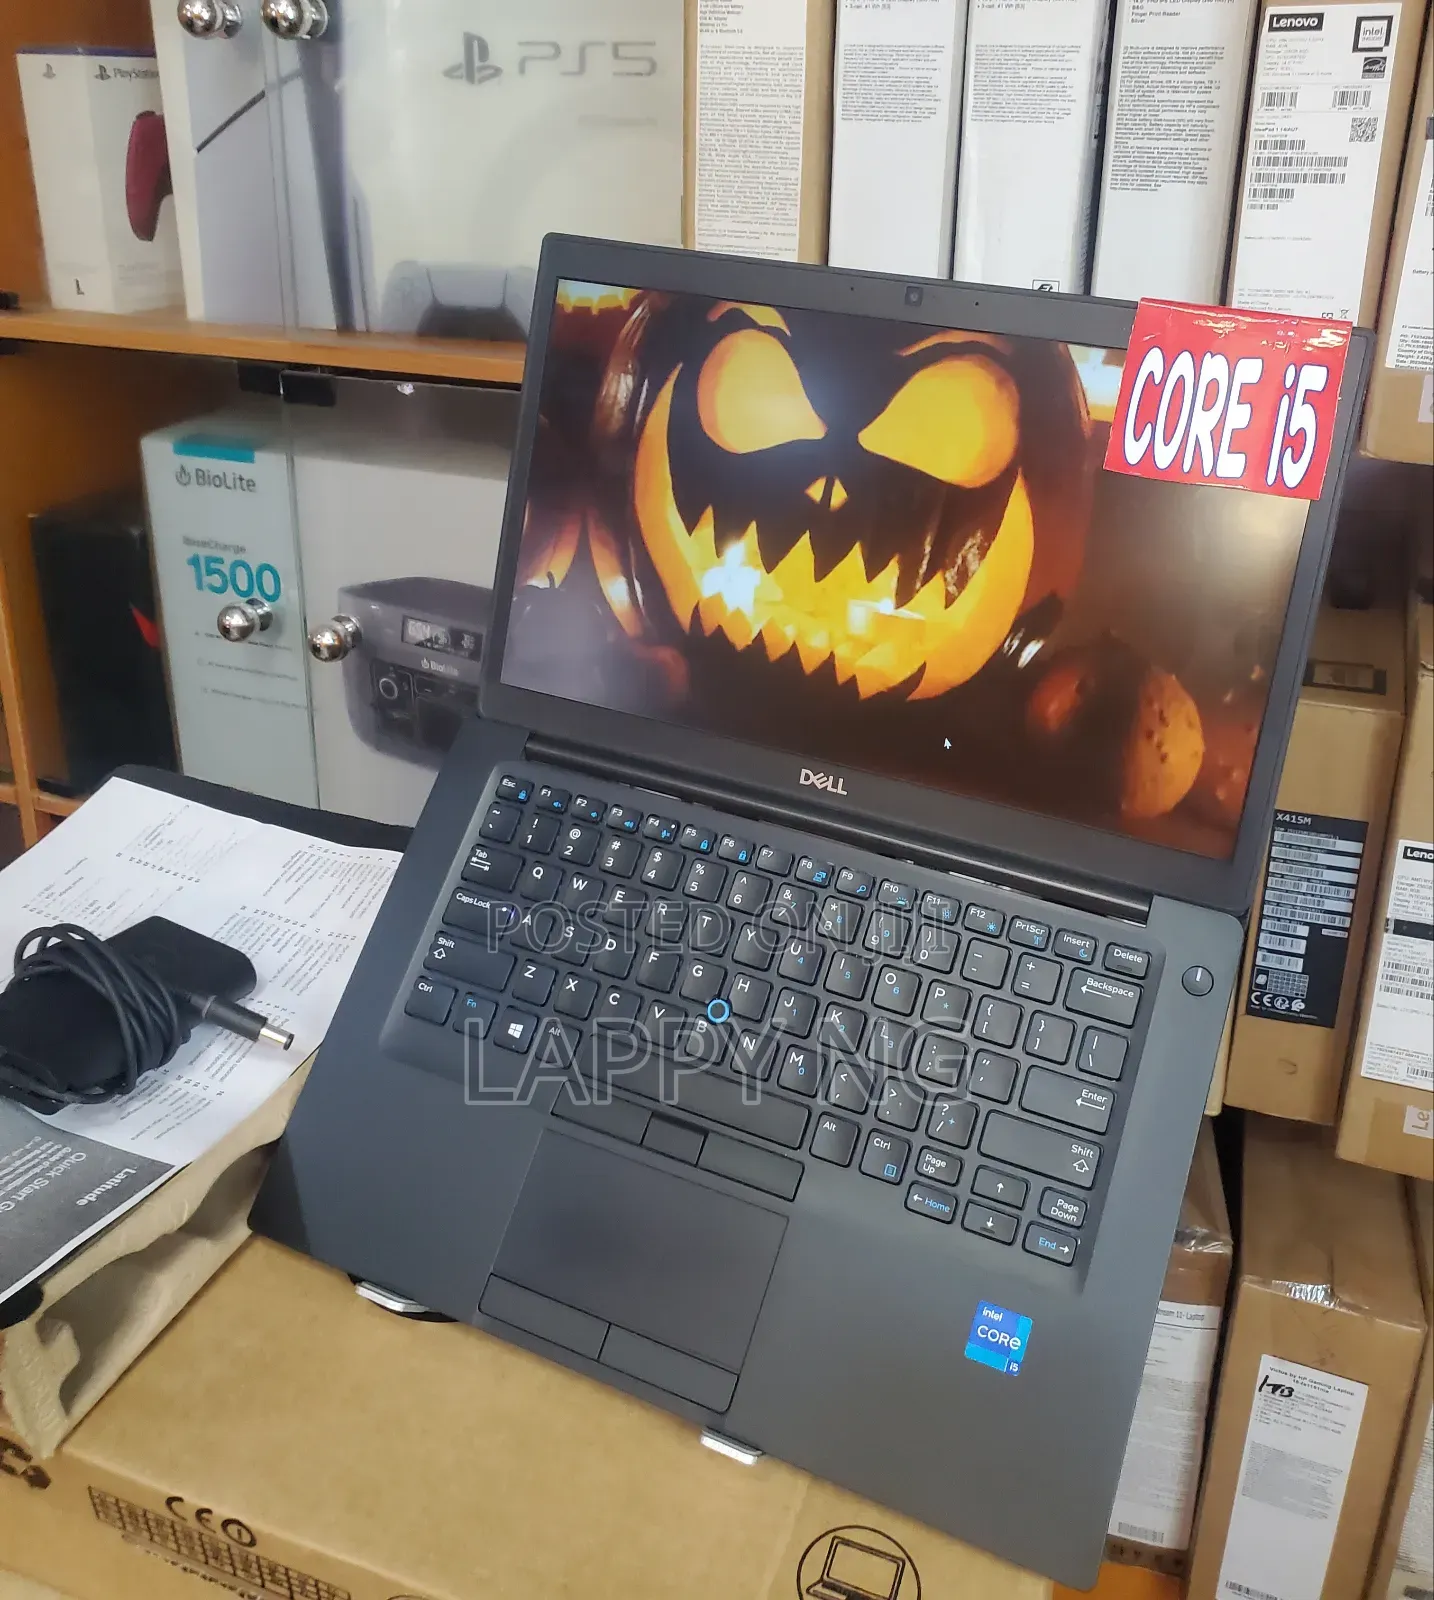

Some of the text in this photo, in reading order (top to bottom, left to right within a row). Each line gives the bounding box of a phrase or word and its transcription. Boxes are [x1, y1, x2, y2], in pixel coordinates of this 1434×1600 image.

[1272, 16, 1319, 28] Lenovo
[1362, 26, 1384, 36] intel
[516, 40, 658, 77] PS5
[1123, 346, 1329, 489] CORE i5
[195, 467, 257, 492] BioLite
[183, 535, 247, 555] BaseCharge
[187, 553, 282, 603] 1500
[502, 778, 517, 788] Esc
[799, 768, 848, 796] DELL
[541, 789, 552, 798] F1
[576, 798, 588, 807] F2
[611, 807, 623, 817] F3
[1275, 812, 1312, 825] X415M
[649, 818, 660, 828] F4
[526, 834, 533, 845] 1
[685, 828, 697, 838] F5
[723, 838, 735, 848] F6
[475, 848, 488, 859] Tab
[563, 845, 574, 856] 2
[762, 849, 774, 859] F7
[605, 856, 614, 867] 3
[801, 860, 813, 870] F8
[532, 866, 544, 880] Q
[647, 869, 657, 879] 4
[841, 871, 854, 881] F9
[572, 877, 588, 891] W
[689, 881, 699, 892] 5
[883, 882, 899, 894] F10
[614, 890, 625, 903] E
[733, 893, 743, 904] 6
[926, 895, 941, 906] F11
[656, 903, 668, 915] R
[970, 908, 986, 919] F12
[521, 914, 532, 926] A
[702, 916, 712, 928] T
[823, 920, 833, 931] 8
[563, 926, 575, 938] S
[745, 928, 756, 942] Y
[1015, 921, 1045, 936] PrtScr
[437, 936, 455, 949] Shift
[605, 938, 617, 951] D
[870, 934, 880, 945] 9
[1063, 934, 1090, 949] Insert
[790, 942, 802, 955] U
[648, 951, 659, 964] F
[1113, 948, 1143, 963] Delete
[839, 958, 845, 970] I
[523, 965, 536, 979] Z
[692, 965, 704, 977] G
[844, 971, 851, 980] 5
[565, 978, 579, 992] X
[885, 972, 897, 985] O
[418, 981, 433, 993] Ctrl
[737, 978, 750, 993] H
[893, 986, 900, 995] 6
[1086, 977, 1135, 999] Backspace
[609, 993, 620, 1005] C
[934, 987, 946, 999] P
[466, 998, 477, 1008] Fn
[784, 996, 795, 1008] J
[654, 1006, 665, 1019] V
[830, 1010, 843, 1024] K
[548, 1026, 561, 1037] Alt
[696, 1020, 708, 1033] B
[880, 1025, 889, 1039] L
[742, 1036, 756, 1051] N
[789, 1051, 804, 1066] M
[1081, 1088, 1108, 1103] Enter
[822, 1120, 836, 1132] Alt
[873, 1137, 891, 1150] Ctrl
[1071, 1143, 1094, 1158] Shift
[46, 1152, 87, 1178] Quick
[925, 1153, 947, 1169] Page
[923, 1163, 935, 1174] Up
[10, 1177, 50, 1201] Start
[75, 1167, 137, 1207] Latitude
[924, 1196, 950, 1213] Home
[1056, 1198, 1080, 1213] Page
[1050, 1207, 1077, 1222] Down
[1038, 1237, 1057, 1250] End
[982, 1306, 1003, 1321] intel
[1269, 1366, 1288, 1376] Victus
[1333, 1386, 1355, 1396] Laptop
